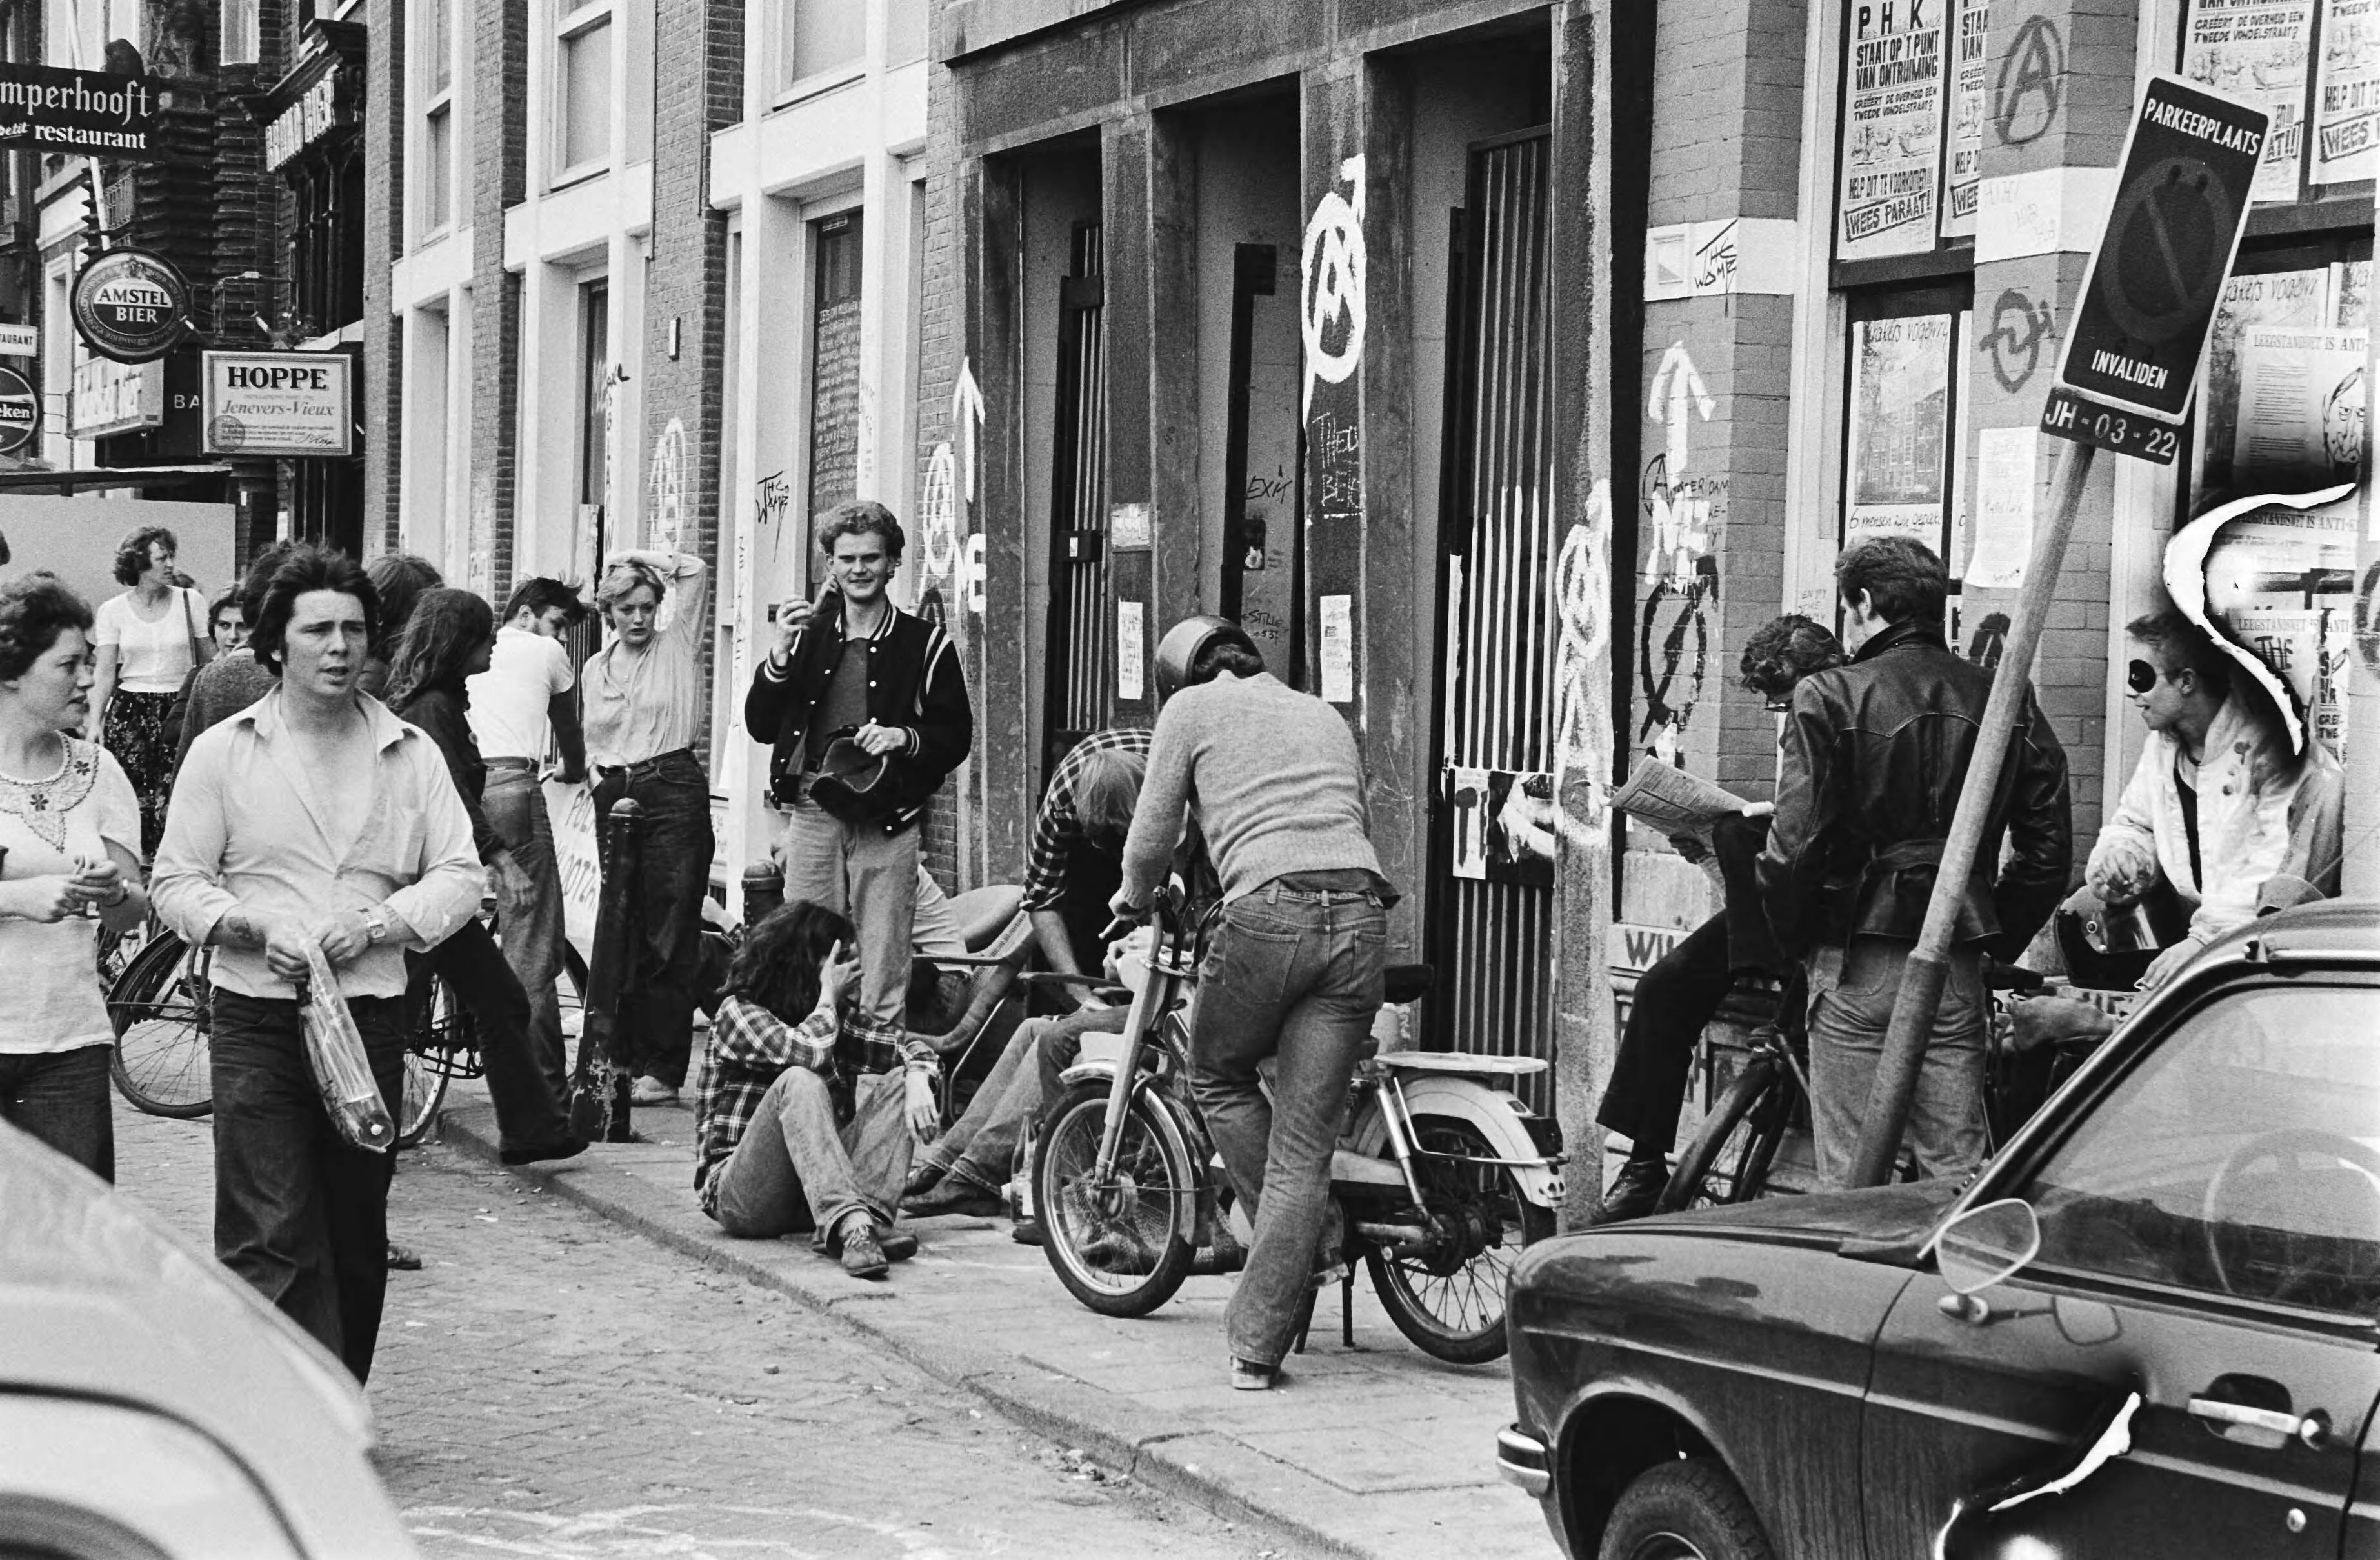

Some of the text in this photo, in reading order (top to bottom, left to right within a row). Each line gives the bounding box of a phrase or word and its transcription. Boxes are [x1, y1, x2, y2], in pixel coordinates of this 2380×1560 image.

[1857, 40, 1887, 67] STAAT
[1890, 37, 1902, 61] OP
[1914, 30, 1939, 57] PUNT
[1963, 35, 1982, 61] VAN
[2195, 30, 2230, 43] TWEEDE
[1856, 55, 1938, 90] VAN ONTRUIMING
[1854, 108, 1880, 121] TWEEDE
[2144, 97, 2261, 155] PARKEERPLAATS
[35, 125, 146, 149] restaurant
[2325, 121, 2369, 154] WEES
[1849, 208, 1880, 235] WEES
[98, 288, 168, 305] AMSTEL
[116, 306, 158, 323] BIER
[228, 366, 329, 390] HOPPE
[2091, 349, 2168, 389] INVALIDEN
[1245, 475, 1293, 504] EXIT
[1849, 508, 1859, 529] 6
